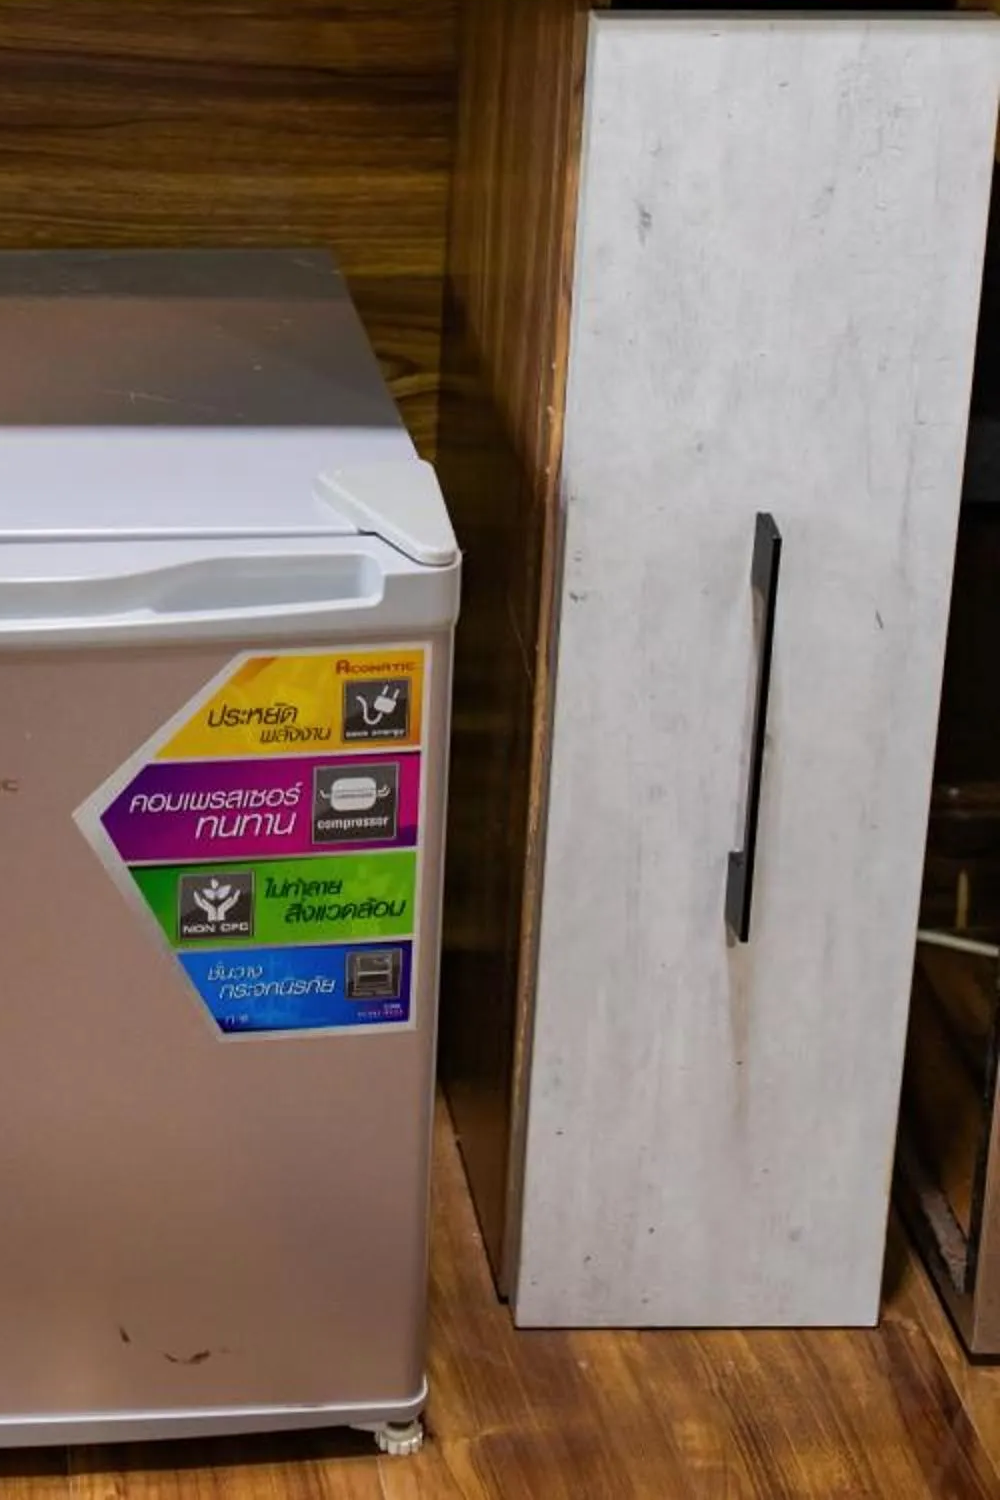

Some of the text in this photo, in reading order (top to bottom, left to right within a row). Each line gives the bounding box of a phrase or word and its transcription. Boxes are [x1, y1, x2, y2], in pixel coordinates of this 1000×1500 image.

[208, 702, 298, 728] ประหยัด
[195, 812, 297, 839] ทนทาน
[317, 817, 389, 830] compressor
[183, 922, 249, 933] NON CFC
